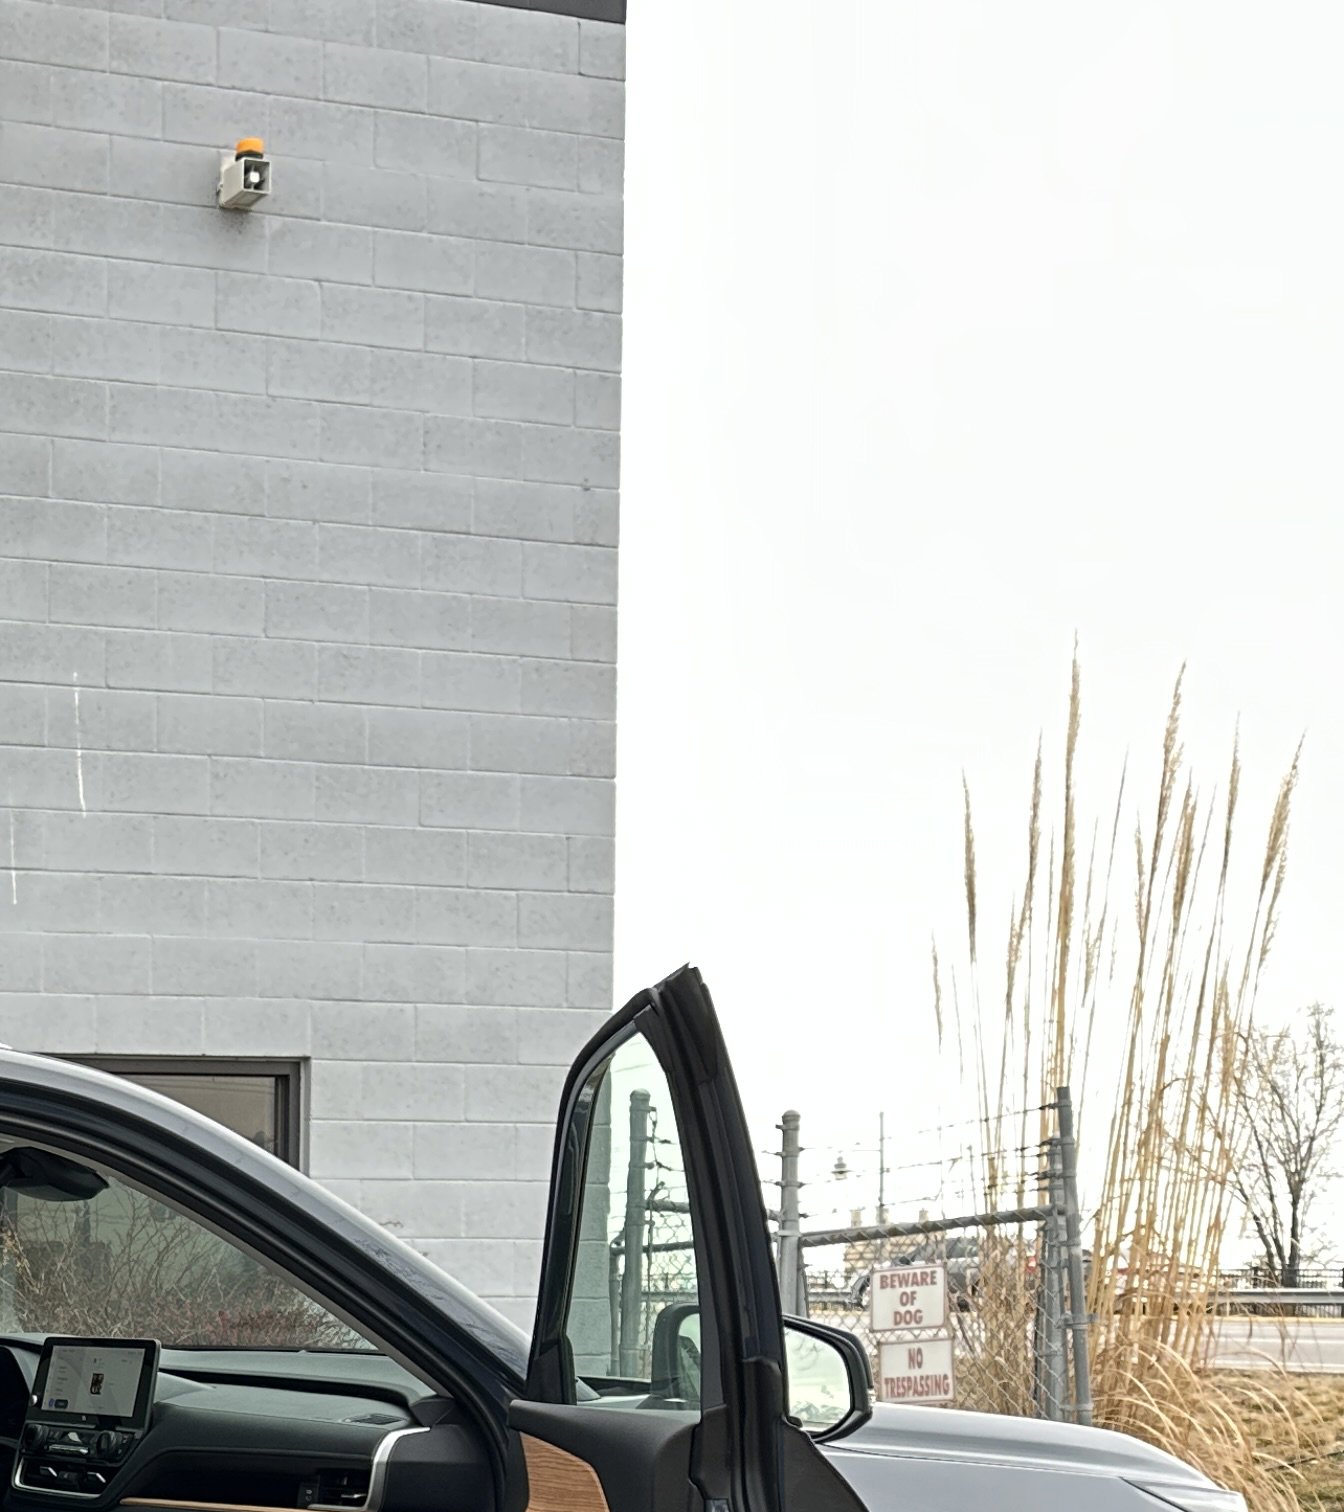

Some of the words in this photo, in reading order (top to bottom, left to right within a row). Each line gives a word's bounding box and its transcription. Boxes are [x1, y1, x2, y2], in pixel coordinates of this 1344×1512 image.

[879, 1270, 938, 1290] BEWARE
[899, 1291, 918, 1307] OF
[893, 1310, 923, 1326] DOG
[907, 1347, 924, 1370] NO
[883, 1373, 950, 1399] TRESPASSING
